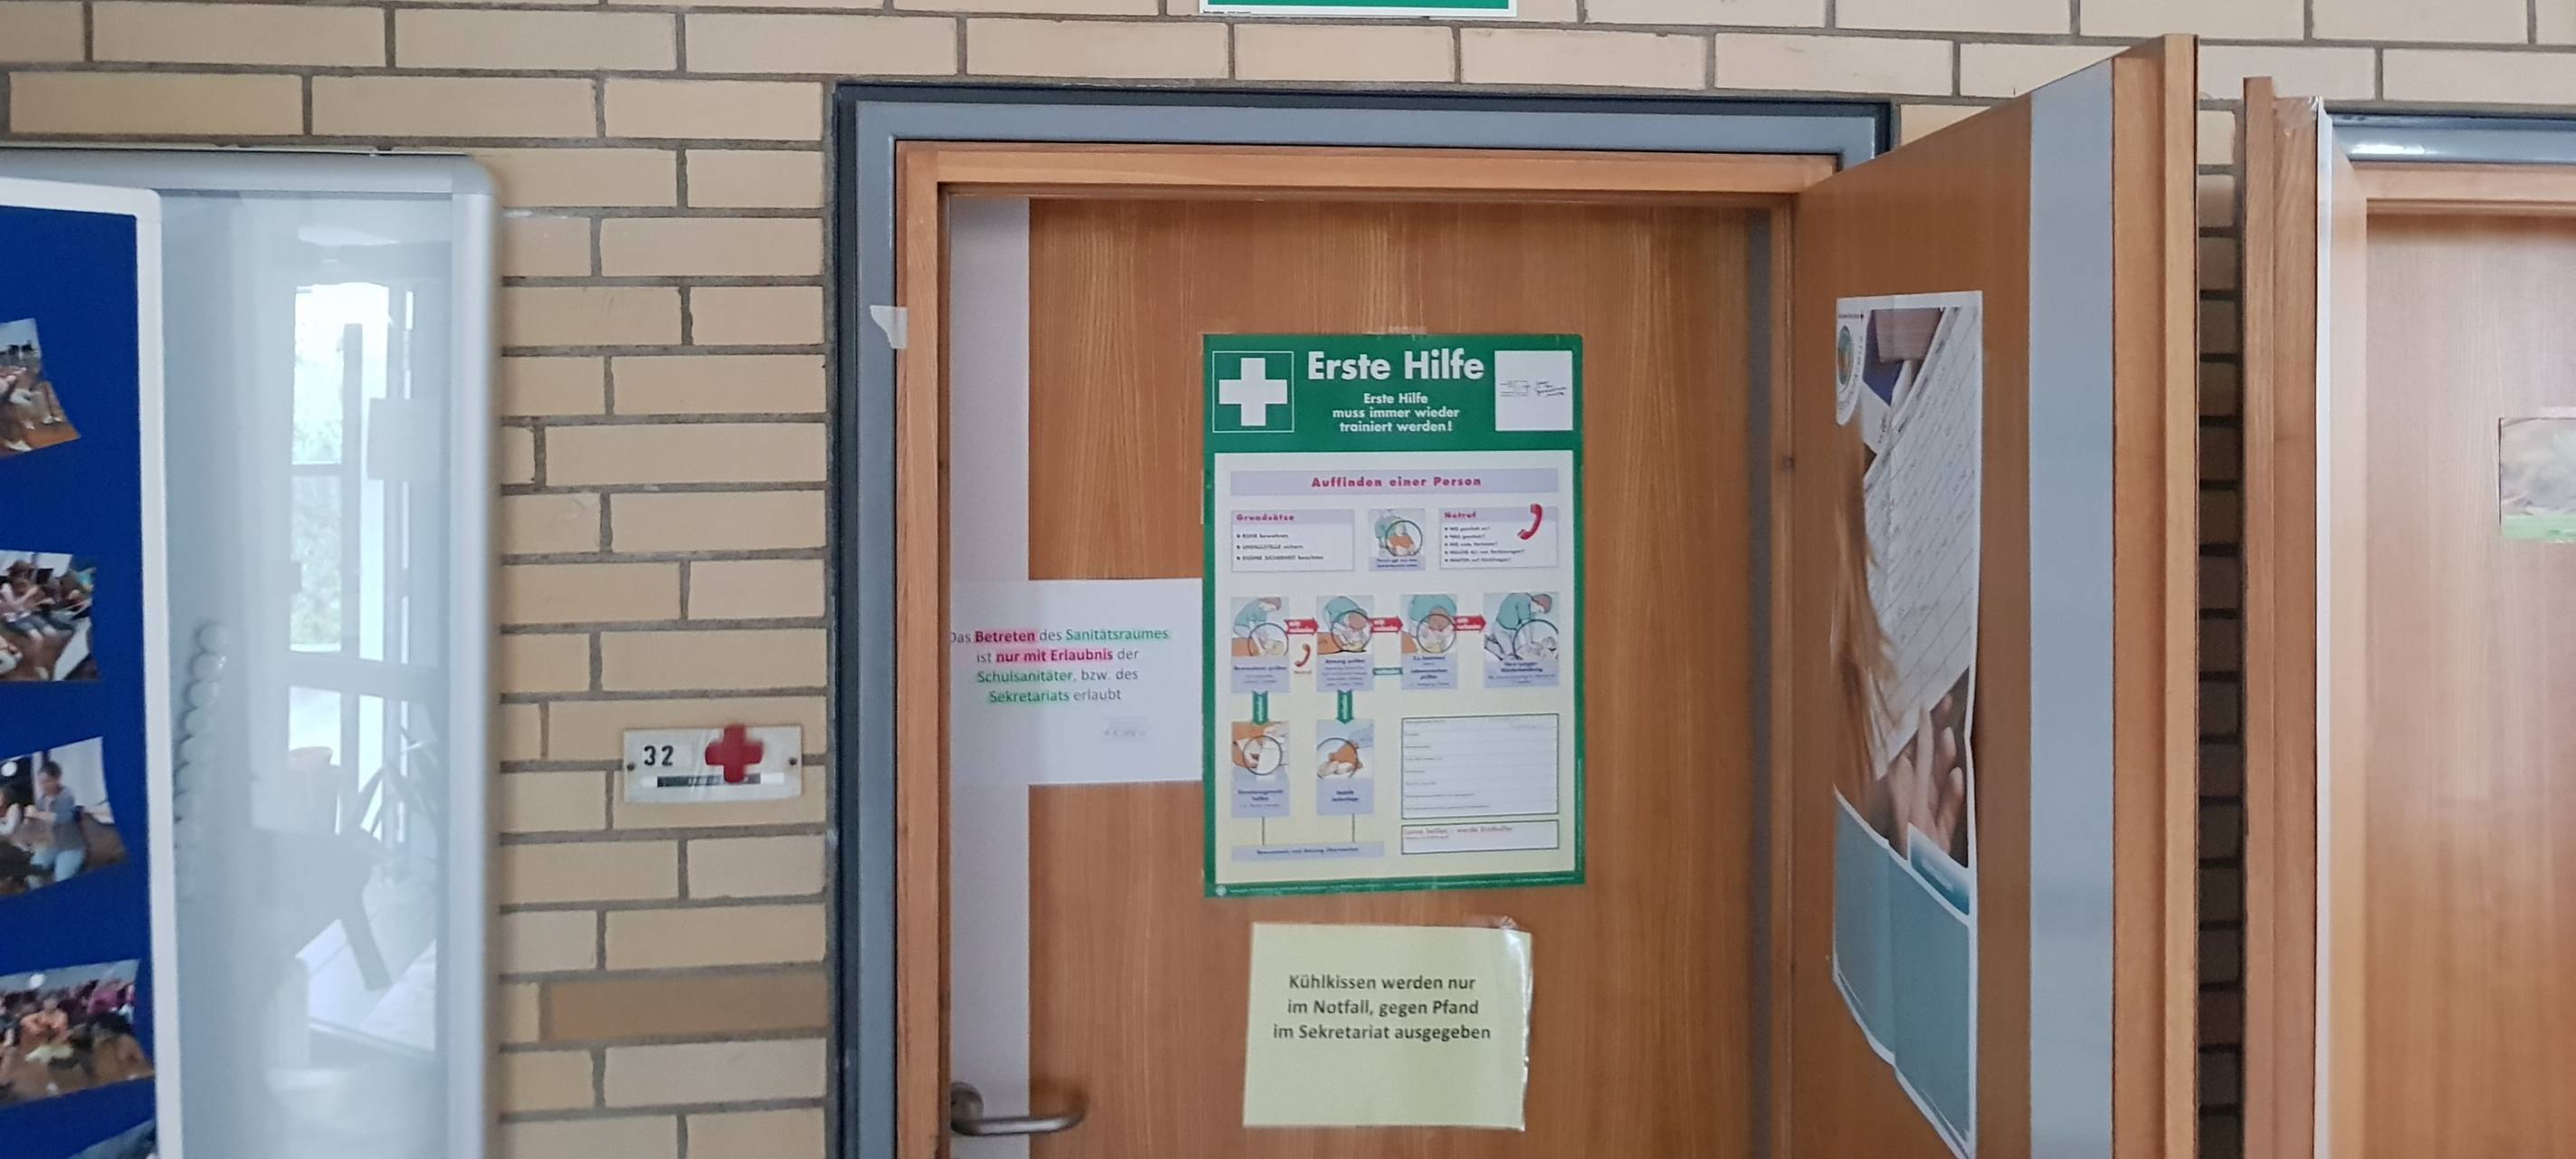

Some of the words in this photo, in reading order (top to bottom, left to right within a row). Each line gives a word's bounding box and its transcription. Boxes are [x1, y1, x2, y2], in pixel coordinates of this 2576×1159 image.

[1308, 350, 1390, 380] Erste
[1404, 348, 1484, 380] Hilfe
[1363, 392, 1394, 405] Erste
[1398, 391, 1428, 404] Hilfe
[1332, 408, 1365, 418] muss
[1369, 407, 1410, 418] immer
[1414, 406, 1461, 417] wieder
[1340, 421, 1392, 432] trainiert
[1397, 420, 1452, 432] werden!
[1312, 476, 1382, 488] Auffinden
[1389, 476, 1426, 487] einer
[1433, 476, 1482, 487] Person
[1444, 511, 1476, 519] Notruf
[974, 630, 1035, 643] Betreten
[1039, 629, 1062, 642] des
[1065, 627, 1169, 641] Sanitätsraumes
[977, 651, 992, 663] ist
[997, 653, 1019, 663] nur
[1024, 649, 1046, 662] mit
[1050, 648, 1113, 662] Erlaubnis
[1117, 648, 1140, 660] der
[978, 670, 1076, 683] Schulsanitäter,
[1081, 668, 1111, 681] bzw.
[1115, 668, 1140, 680] des
[988, 690, 1071, 703] Sekretariats
[1073, 688, 1122, 701] erlaubt
[644, 745, 674, 766] 32
[1289, 974, 1377, 990] Kühlkissen
[1381, 974, 1443, 990] werden
[1447, 978, 1476, 990] nur
[1287, 1000, 1307, 1014] im
[1313, 999, 1374, 1016] Notfall,
[1379, 1002, 1427, 1018] gegen
[1433, 999, 1479, 1014] Pfand
[1274, 1024, 1293, 1039] im
[1299, 1024, 1390, 1039] Sekretariat
[1394, 1024, 1492, 1042] ausgegeben
